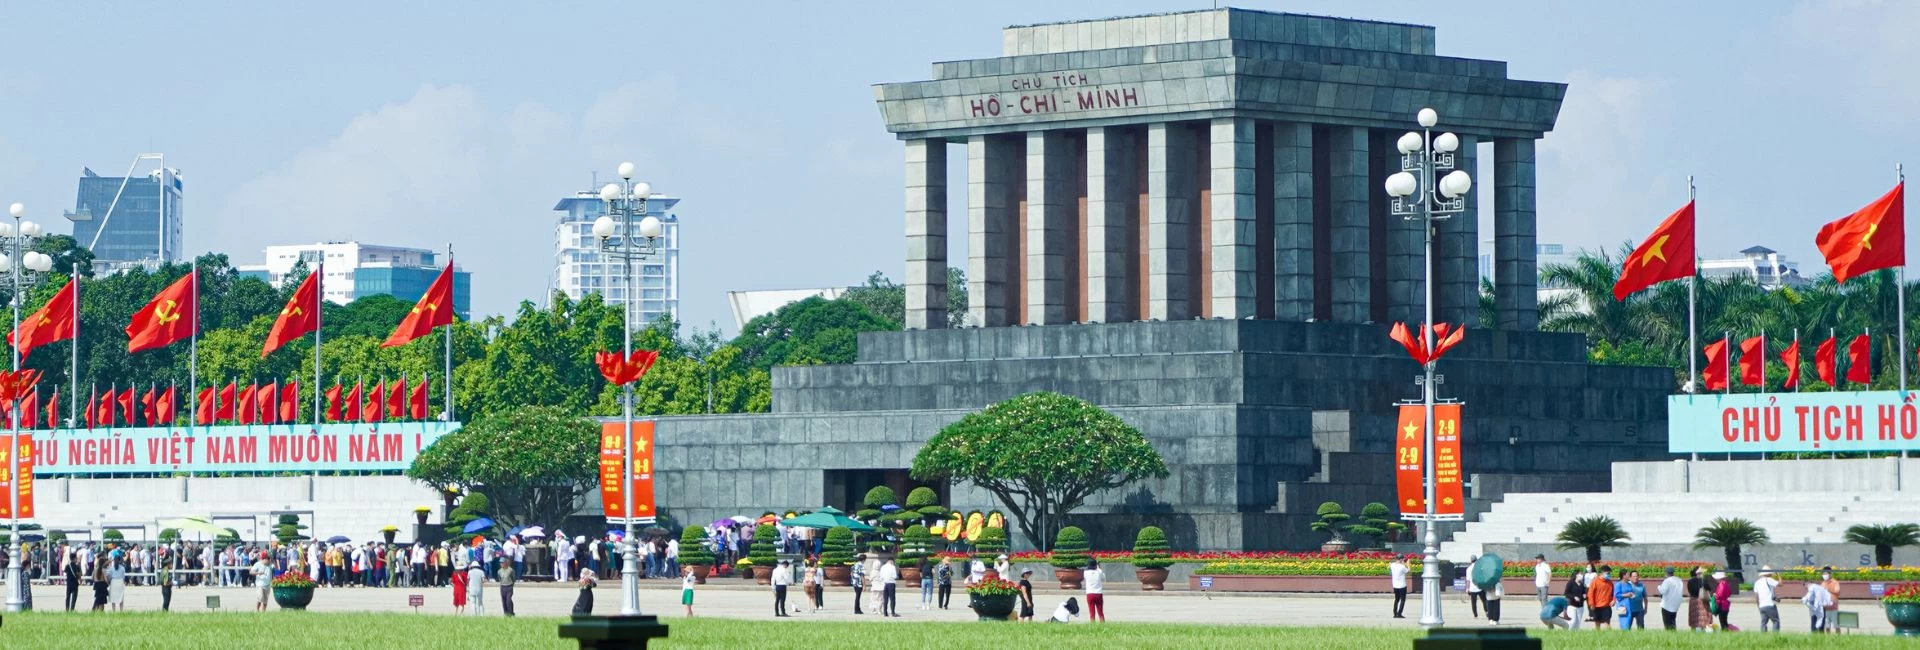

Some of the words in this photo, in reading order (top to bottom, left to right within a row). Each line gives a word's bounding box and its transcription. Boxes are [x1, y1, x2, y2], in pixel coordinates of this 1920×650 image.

[1438, 419, 1455, 436] 2-9
[1722, 395, 1781, 443] CHỦ
[1794, 405, 1863, 449] TỊCH
[1878, 391, 1918, 440] HỒ
[32, 431, 58, 466] HỦ
[68, 432, 136, 466] NGHĨA
[147, 431, 196, 470] VIỆT
[206, 435, 257, 464] NAM
[268, 428, 337, 463] MUÔN
[348, 427, 403, 462] NĂM
[1399, 446, 1418, 464] 2-9
